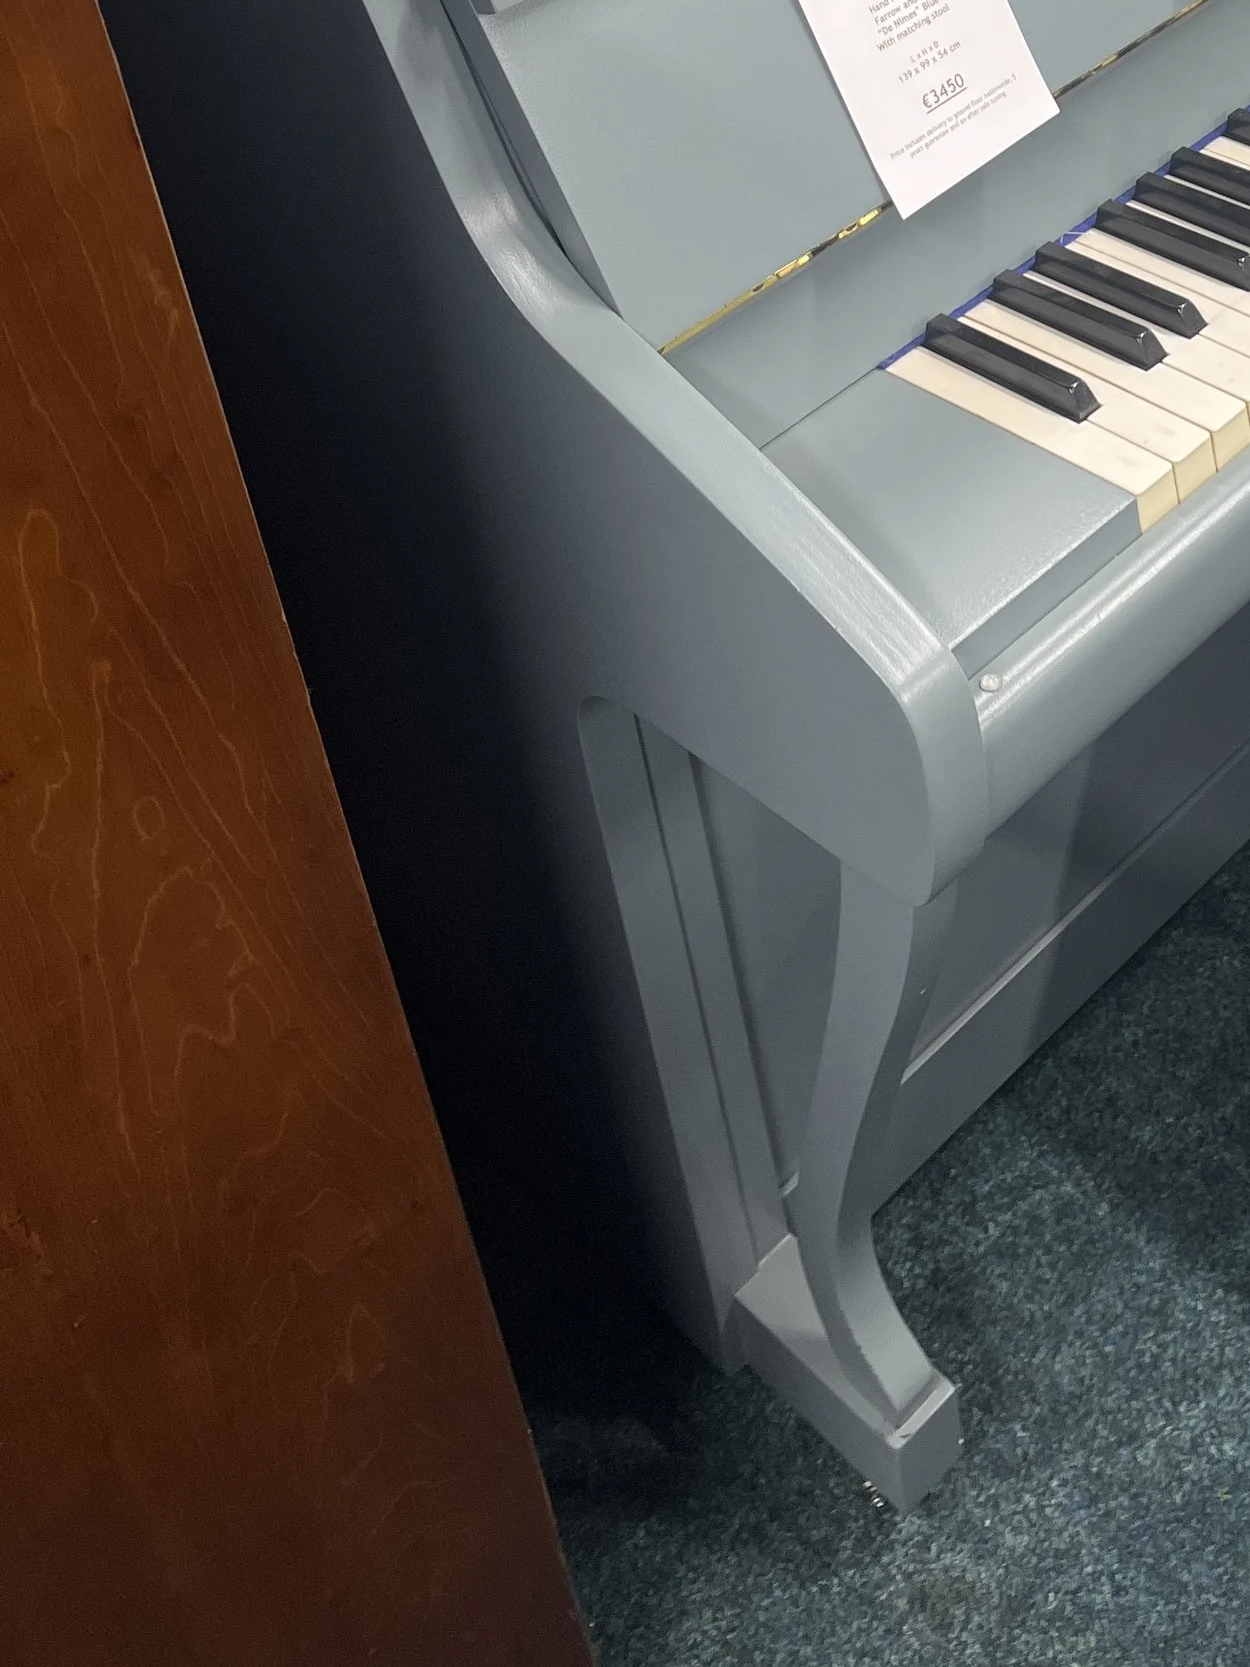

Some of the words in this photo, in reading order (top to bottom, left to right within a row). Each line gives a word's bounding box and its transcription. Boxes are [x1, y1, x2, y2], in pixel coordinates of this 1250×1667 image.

[874, 5, 901, 26] Farrow
[876, 35, 896, 52] With
[896, 15, 932, 42] matching
[930, 3, 950, 20] stool
[898, 69, 913, 84] 139
[914, 66, 921, 75] x
[920, 58, 931, 70] 99
[931, 55, 938, 65] x
[937, 48, 949, 60] 54
[949, 40, 962, 53] cm
[910, 55, 916, 63] L
[920, 47, 928, 56] H
[932, 40, 939, 49] D
[922, 73, 965, 108] €3450
[890, 147, 905, 160] Price
